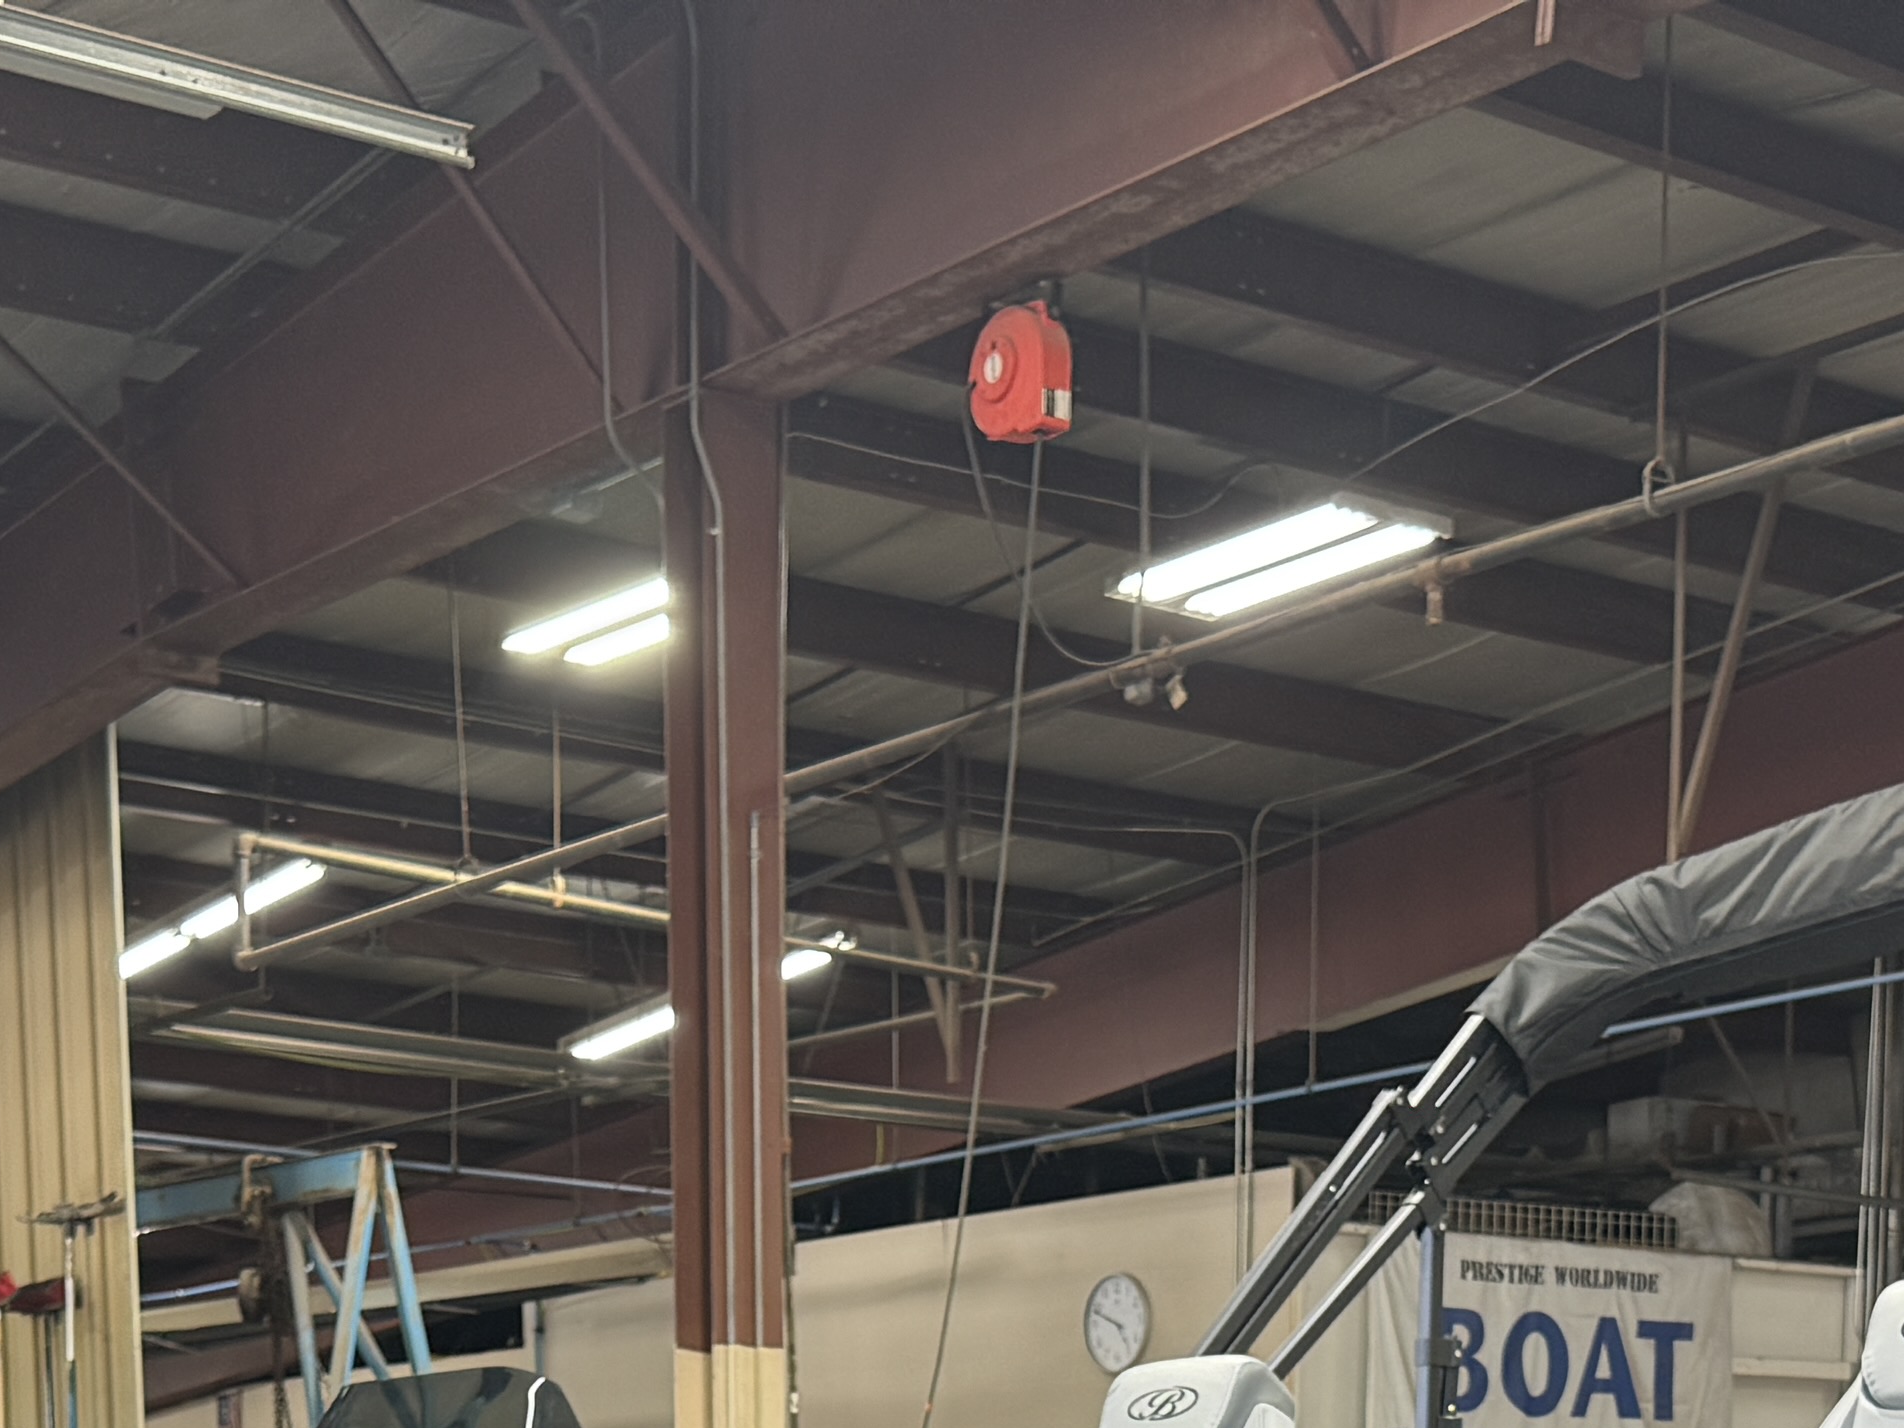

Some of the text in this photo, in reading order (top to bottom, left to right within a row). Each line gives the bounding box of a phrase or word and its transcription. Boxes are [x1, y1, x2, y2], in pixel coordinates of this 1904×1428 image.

[1460, 1259, 1660, 1294] PRESTIGE WORLDWIDE
[1441, 1306, 1693, 1421] BOAT
